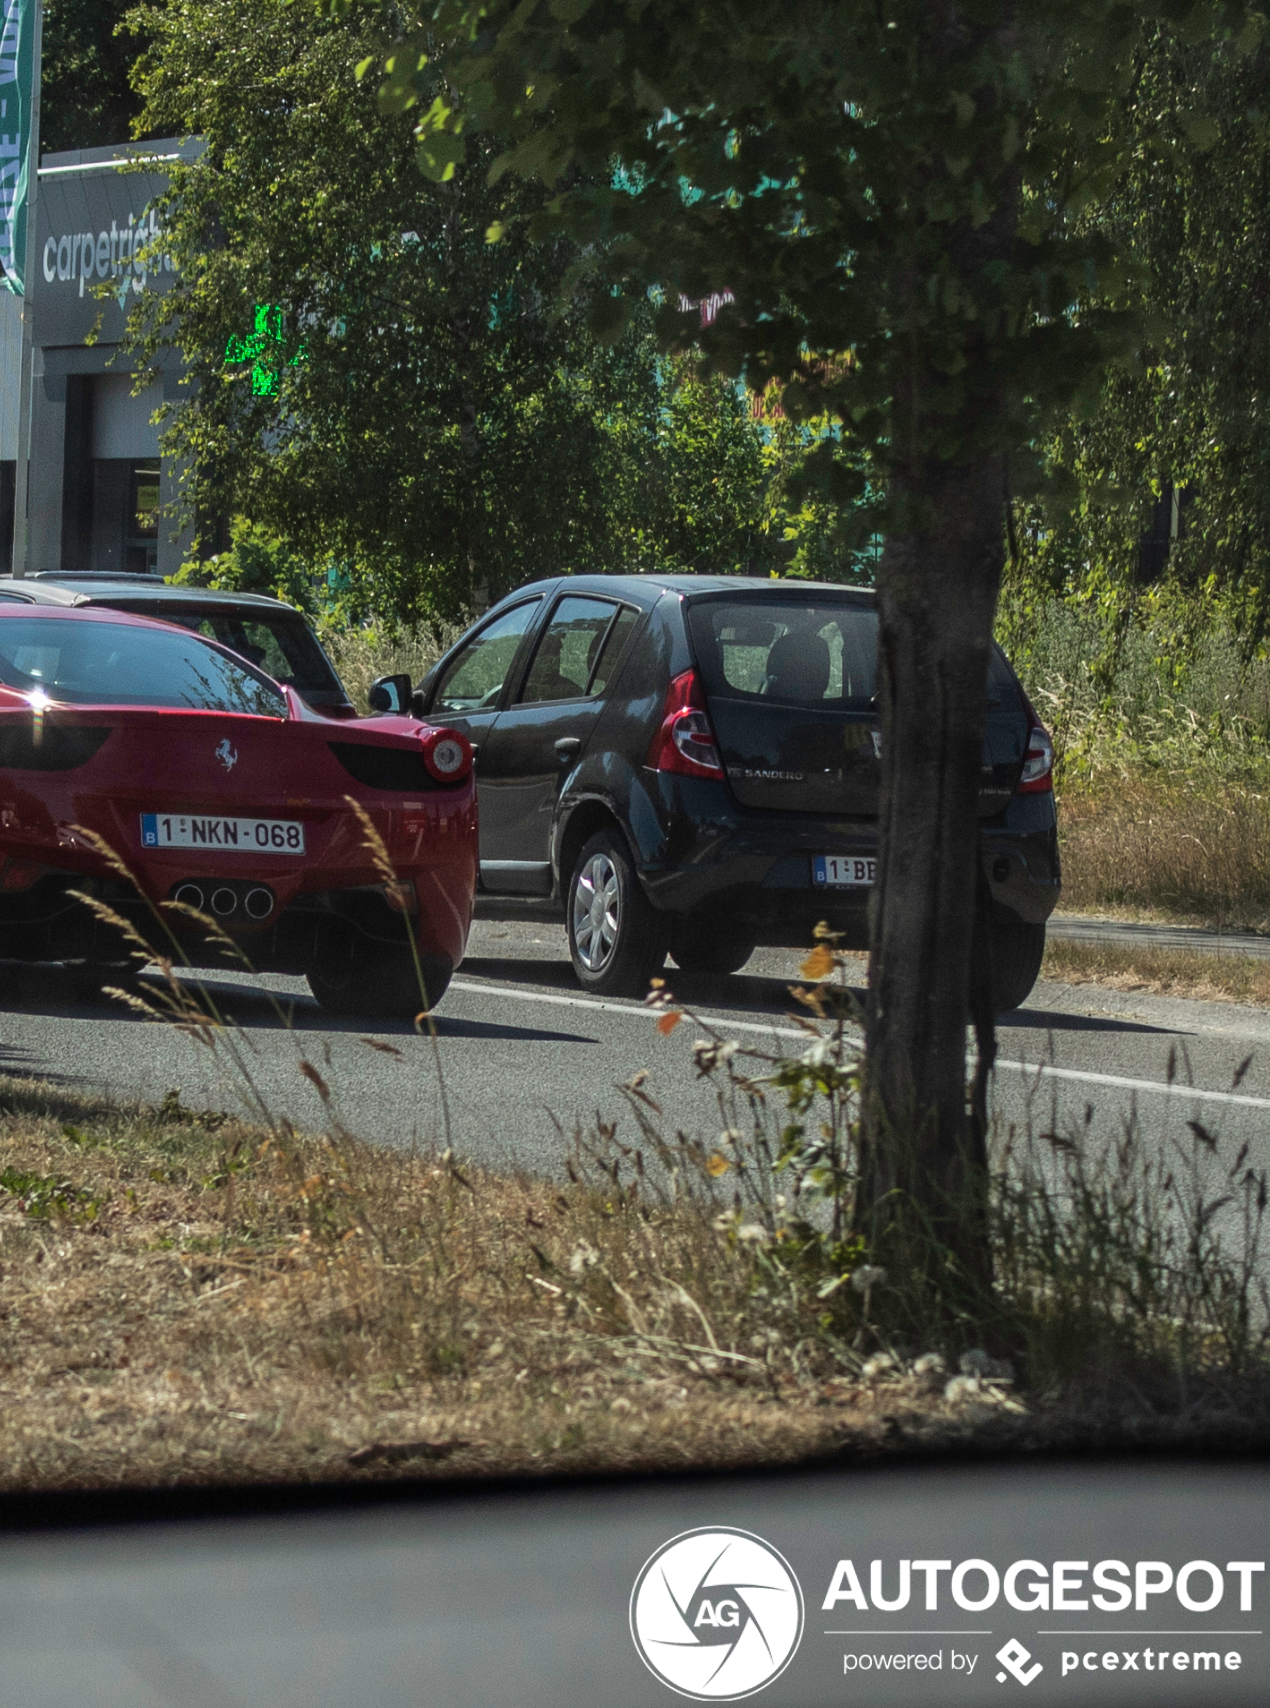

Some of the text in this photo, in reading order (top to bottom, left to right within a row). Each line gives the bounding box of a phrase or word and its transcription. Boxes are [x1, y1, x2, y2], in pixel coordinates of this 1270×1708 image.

[43, 208, 177, 298] carpetrigh
[744, 769, 804, 781] SANDERO
[145, 832, 156, 844] B
[817, 871, 826, 881] B
